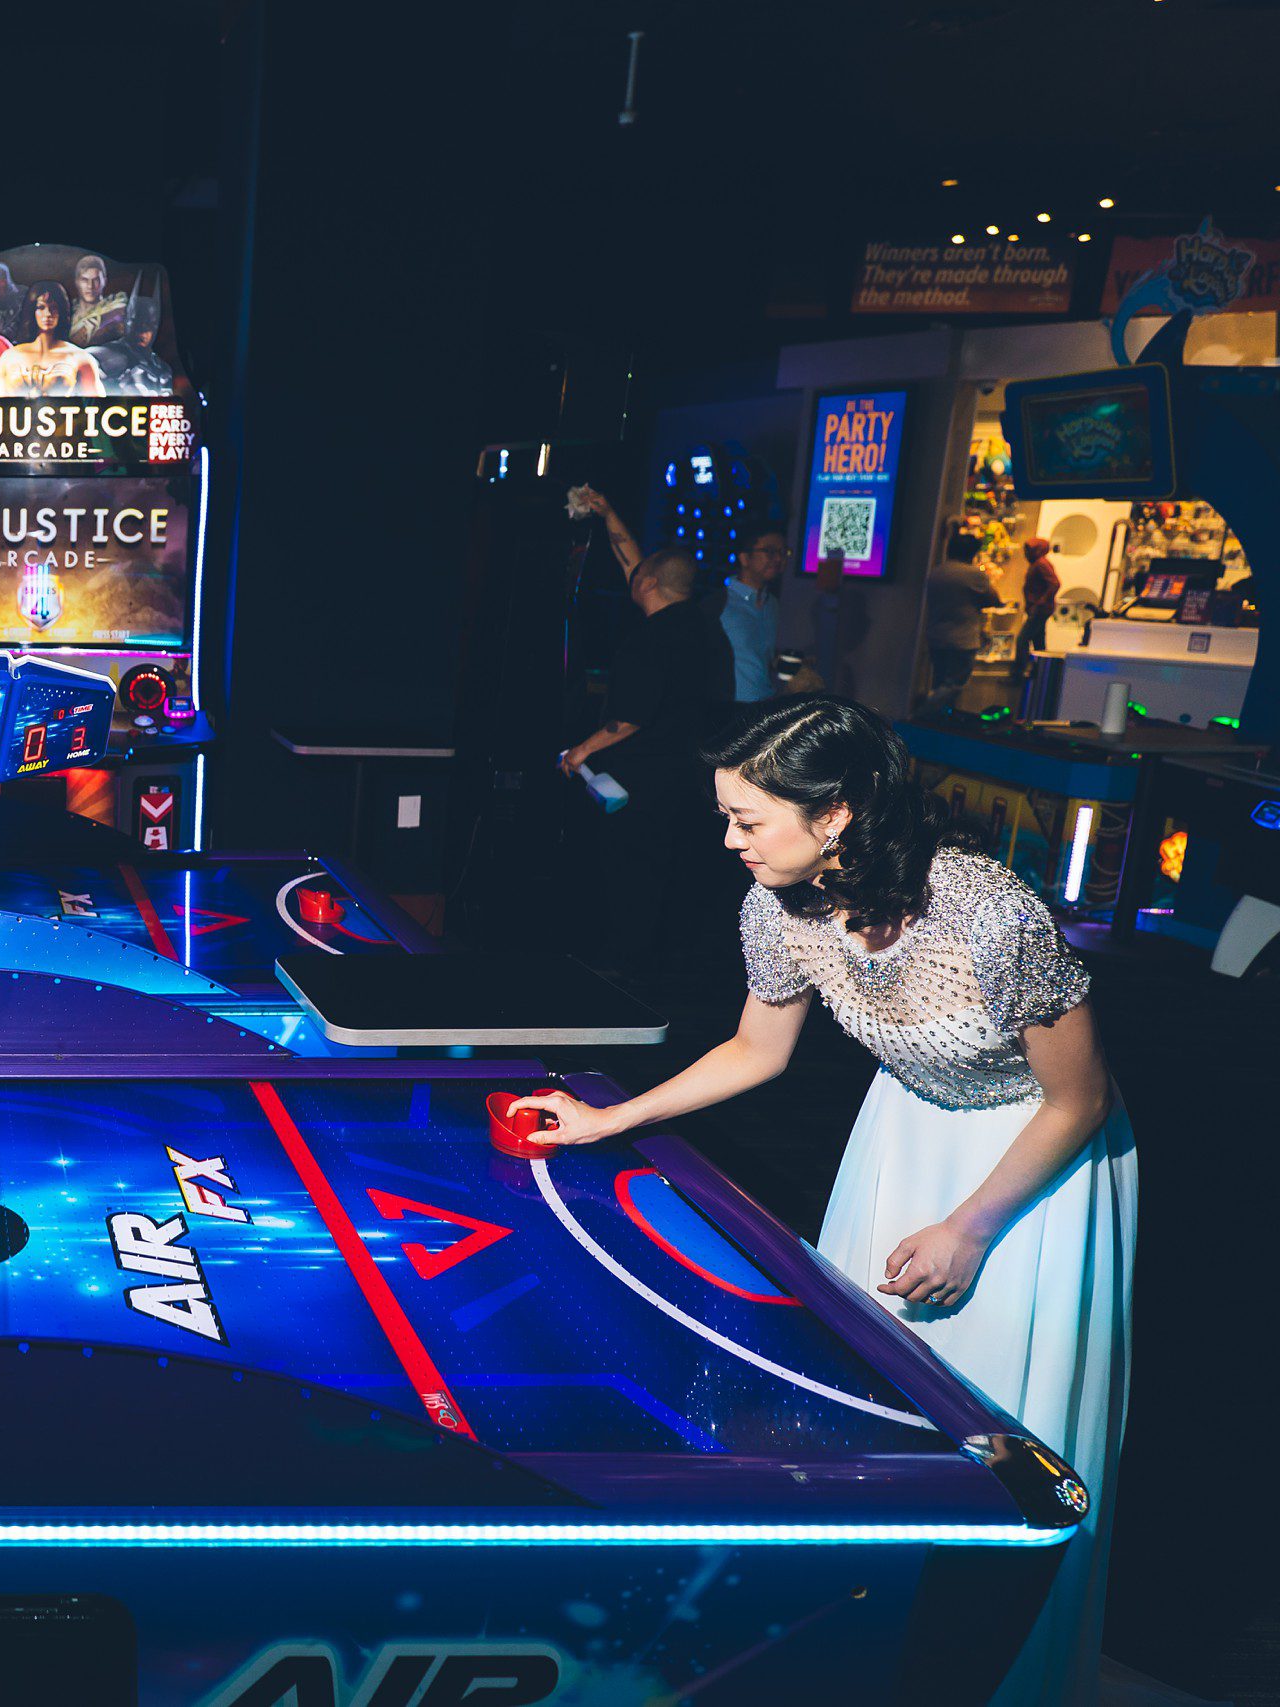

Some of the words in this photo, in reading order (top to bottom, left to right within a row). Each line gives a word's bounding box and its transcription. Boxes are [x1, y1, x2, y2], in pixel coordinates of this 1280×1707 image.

[865, 243, 939, 263] Winners
[942, 243, 1002, 263] aren't
[1003, 244, 1051, 263] born.
[862, 264, 932, 287] They're
[934, 264, 990, 284] made
[993, 262, 1068, 289] through
[858, 287, 890, 305] the
[893, 287, 970, 306] method.
[150, 404, 184, 419] FREE
[150, 419, 191, 432] CARD
[824, 411, 895, 443] PARTY
[149, 432, 195, 446] EVERY
[149, 446, 190, 460] PLAY!
[823, 443, 886, 474] HERO!
[73, 704, 93, 714] TIME
[24, 726, 46, 762] 0
[71, 726, 86, 751] 3
[66, 748, 90, 760] HOME
[17, 759, 49, 774] AWAY
[162, 1143, 255, 1225] FX
[105, 1211, 231, 1348] AIR
